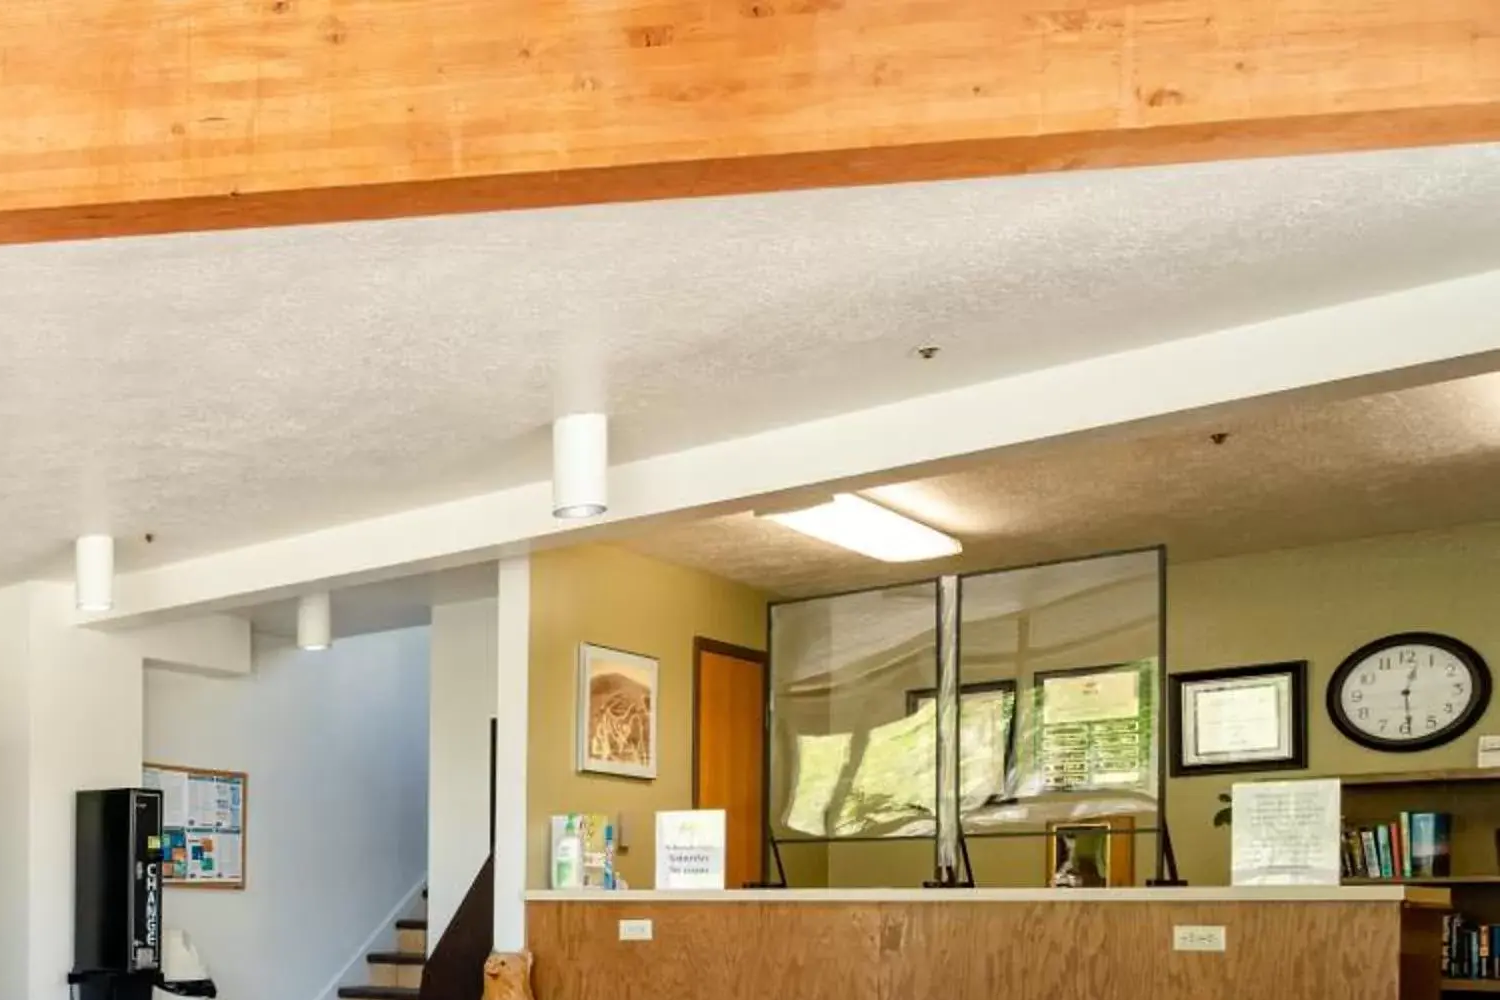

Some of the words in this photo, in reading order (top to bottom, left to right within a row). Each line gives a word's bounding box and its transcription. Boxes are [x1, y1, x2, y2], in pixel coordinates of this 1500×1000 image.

[1379, 658, 1391, 670] 11
[1400, 651, 1416, 664] 12
[1445, 664, 1456, 677] 2
[1360, 673, 1376, 685] 10
[1452, 682, 1464, 695] 3
[1351, 690, 1363, 703] 9
[1358, 707, 1369, 719] 8
[1443, 703, 1453, 714] 4
[1378, 719, 1388, 732] 7
[1426, 715, 1437, 730] 5
